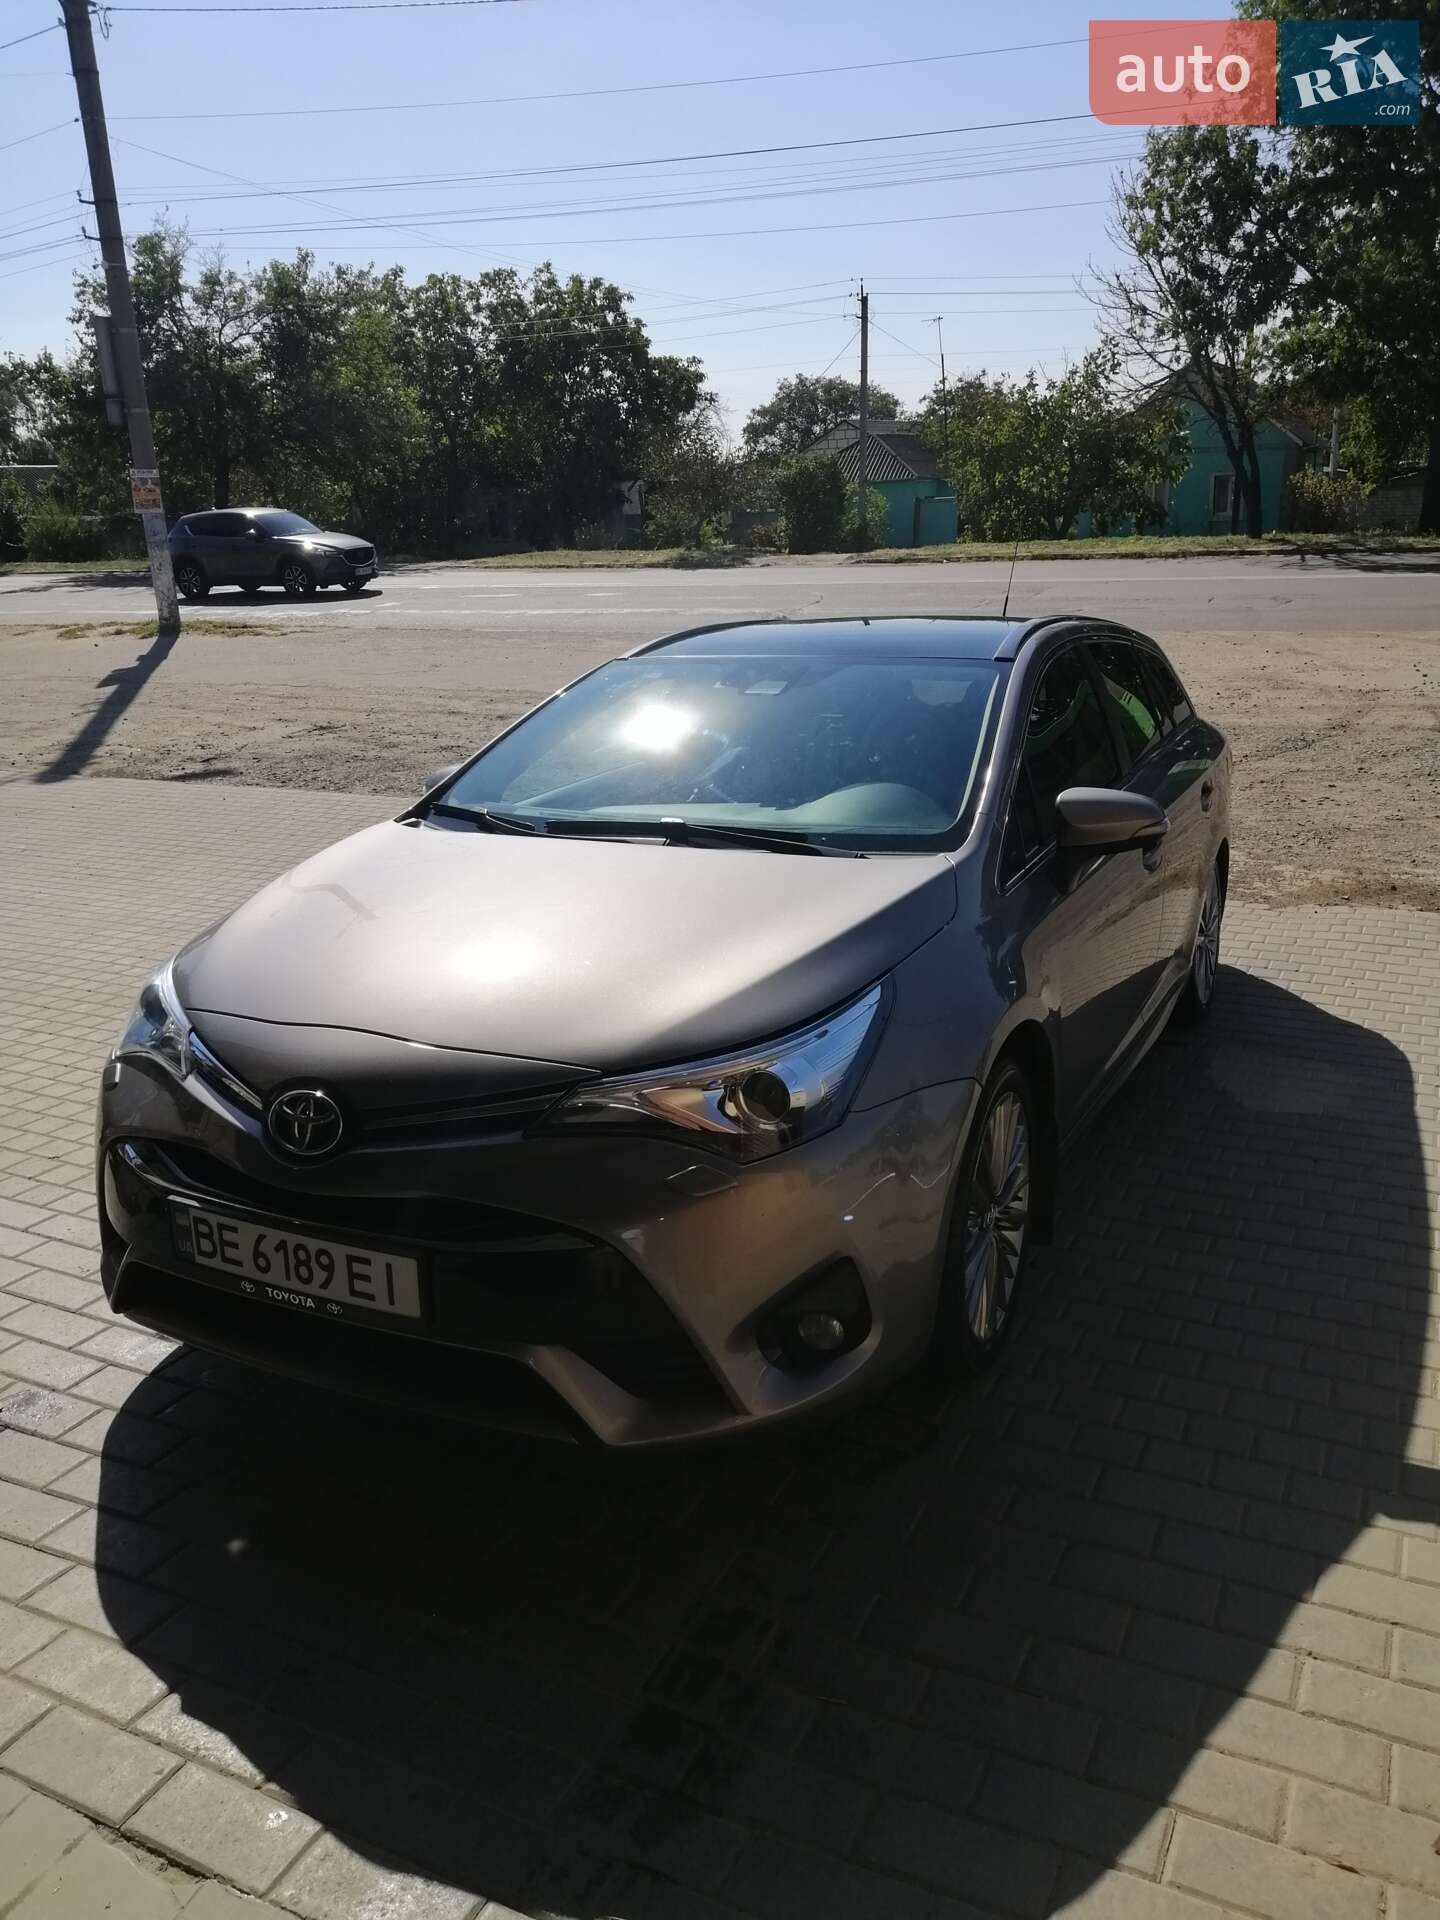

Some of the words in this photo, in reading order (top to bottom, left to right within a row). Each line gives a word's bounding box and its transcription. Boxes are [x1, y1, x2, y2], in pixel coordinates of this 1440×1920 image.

[192, 1215, 244, 1268] BE
[252, 1233, 335, 1290] 6189
[345, 1253, 396, 1306] EI
[266, 1287, 315, 1309] TOYOTA
